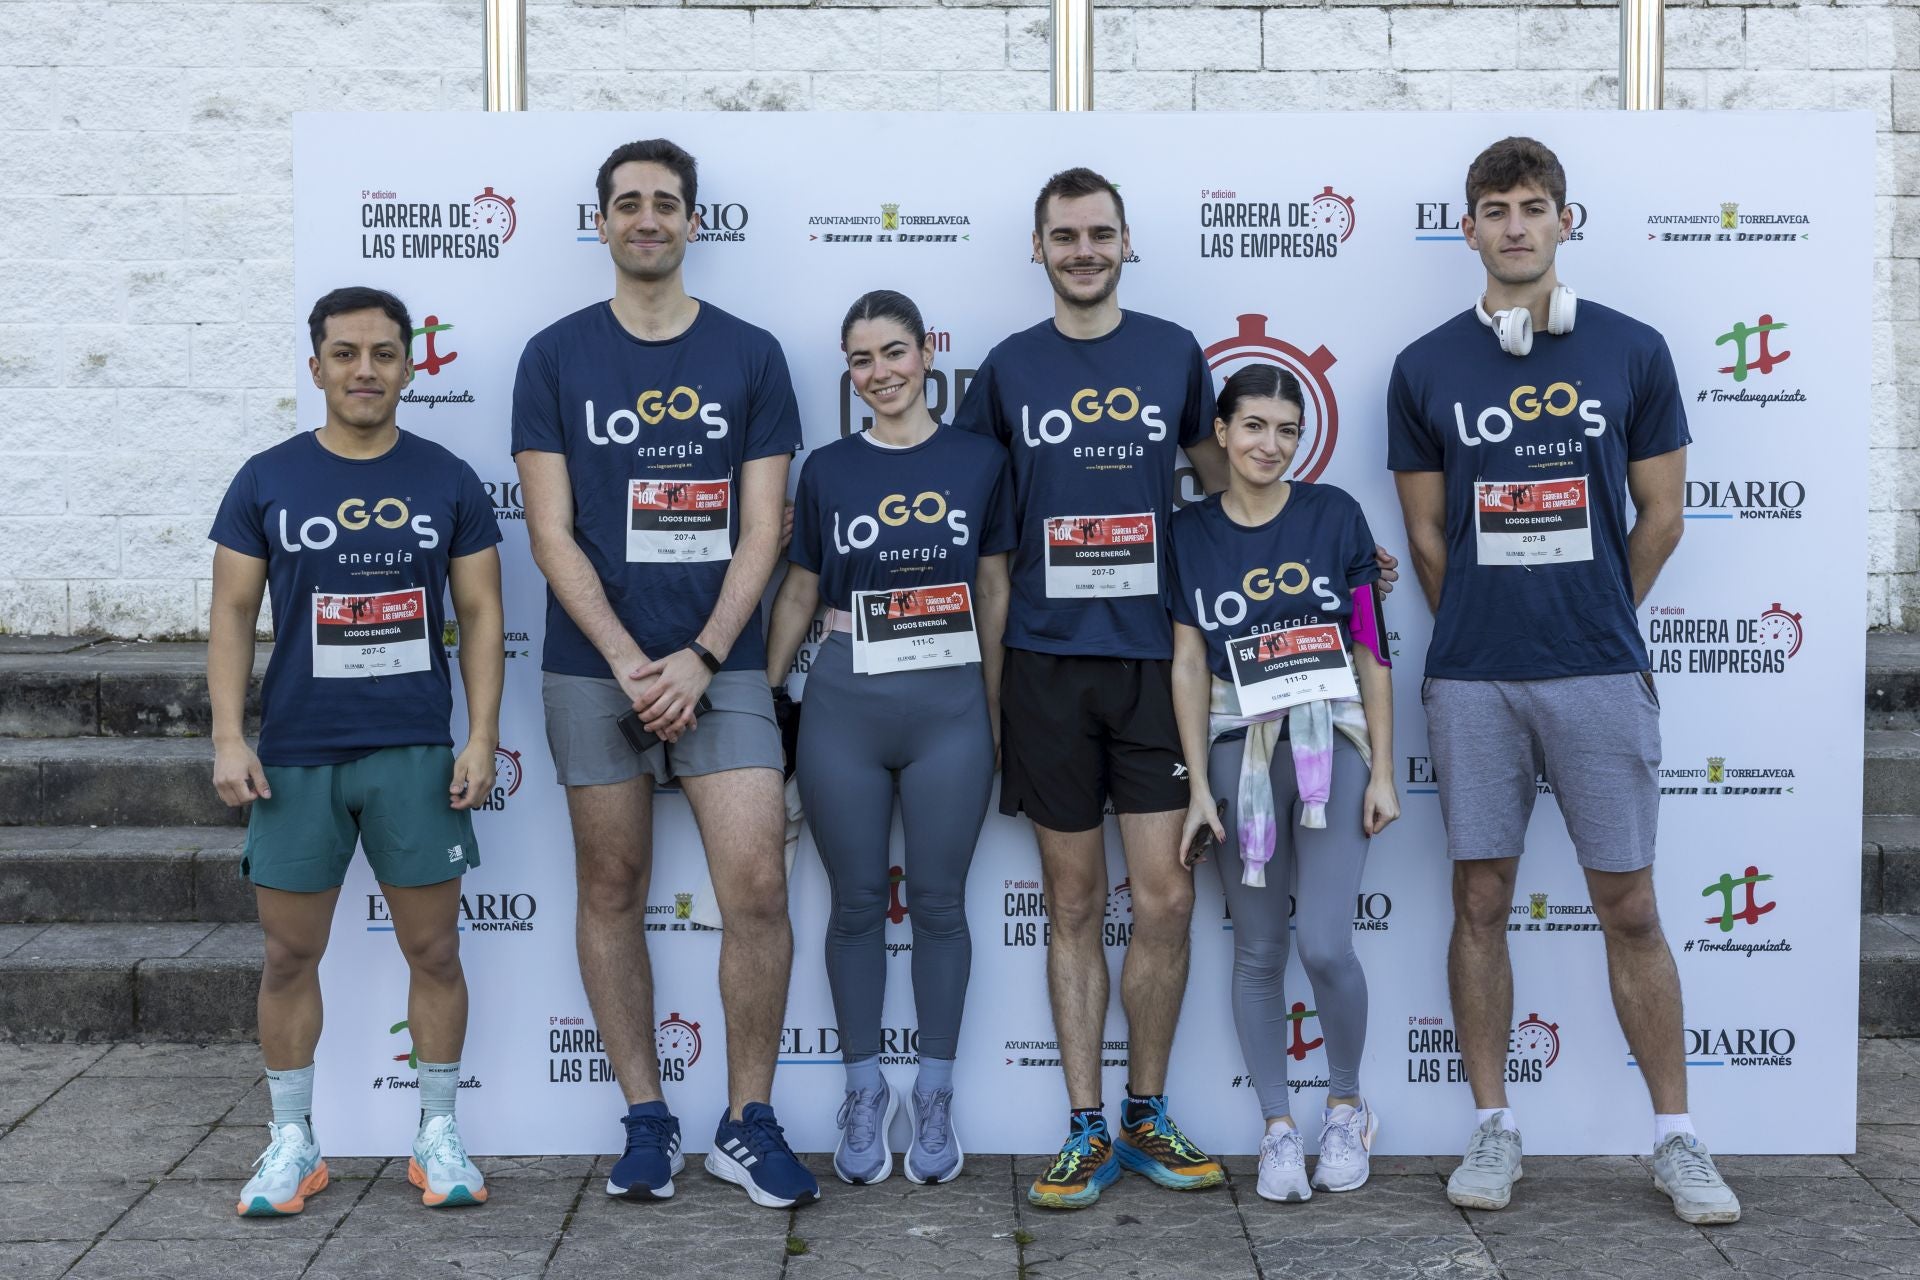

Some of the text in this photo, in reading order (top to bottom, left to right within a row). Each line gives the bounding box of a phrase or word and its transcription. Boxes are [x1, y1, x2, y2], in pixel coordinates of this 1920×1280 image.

[371, 190, 397, 199] edición
[1211, 190, 1236, 199] edición
[362, 203, 471, 228] CARRERA DE
[808, 215, 971, 225] AYUNTAMIENTO TORRELAVEGA
[1201, 203, 1310, 227] CARRERA DE
[1416, 203, 1459, 229] EL
[1647, 214, 1810, 224] AYUNTAMIENTO TORRELAVEGA
[362, 233, 500, 259] LAS EMPRESAS
[1200, 233, 1338, 258] LAS EMPRESAS
[1710, 388, 1807, 408] Torrelaveganízate
[638, 441, 703, 458] energía
[1073, 442, 1144, 460] energía
[1514, 438, 1583, 456] energía
[638, 490, 657, 504] 10K
[1484, 493, 1502, 507] 10K
[1683, 480, 1806, 508] DIARIO
[1531, 515, 1562, 523] ENERGÍA
[1740, 508, 1802, 519] MONTAÑÉS
[674, 533, 697, 541] 207-A
[1054, 527, 1072, 541] 10K
[339, 549, 413, 565] energía
[880, 545, 947, 561] energía
[1101, 549, 1131, 557] ENERGÍA
[322, 605, 341, 620] 10K
[870, 602, 887, 616] 5K
[1660, 606, 1685, 615] edición
[371, 626, 401, 636] ENERGÍA
[893, 618, 948, 631] LOGOS ENERGÍA
[1650, 619, 1758, 644] CARRERA DE
[912, 637, 935, 647] 111-C
[361, 647, 386, 655] 207-C
[1240, 647, 1257, 662] 5K
[1264, 656, 1320, 672] LOGOS ENERGÍA
[1650, 649, 1786, 674] LAS EMPRESAS
[1284, 674, 1308, 684] 111-D
[1724, 768, 1796, 778] TORRELAVEGA
[1660, 787, 1698, 795] ENTIR
[1014, 880, 1039, 889] edición
[472, 920, 534, 931] MONTAÑÉS
[1004, 922, 1036, 947] LAS
[1698, 938, 1792, 958] Torrelaveganízate
[560, 1016, 584, 1025] edición
[1418, 1016, 1443, 1025] edición
[1731, 1055, 1792, 1066] MONTAÑÉS
[550, 1059, 582, 1083] LAS
[1408, 1058, 1440, 1083] LAS
